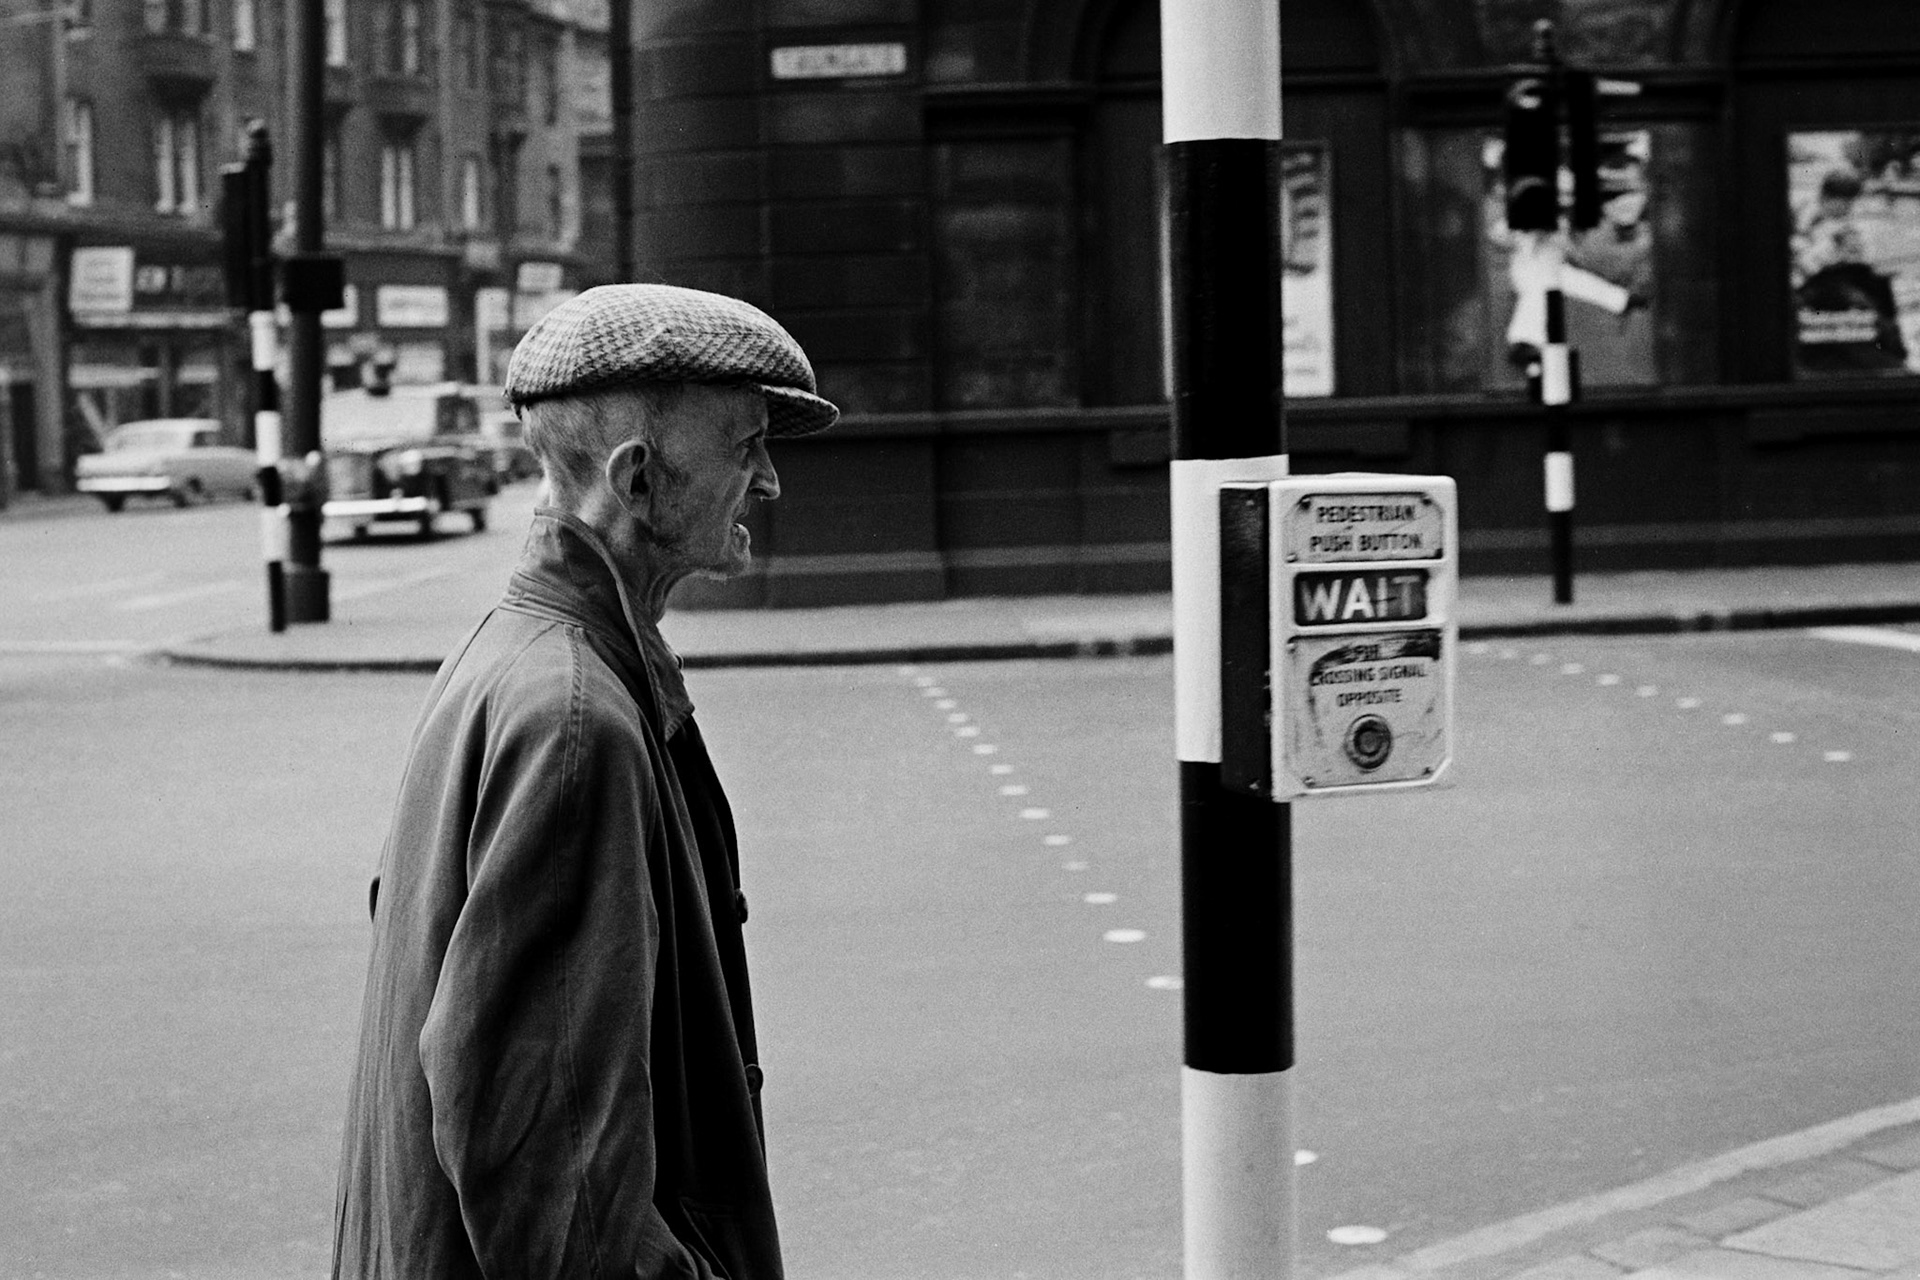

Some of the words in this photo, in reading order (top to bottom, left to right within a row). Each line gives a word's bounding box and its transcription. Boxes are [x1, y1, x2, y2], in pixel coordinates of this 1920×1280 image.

[1316, 505, 1416, 522] PEDESTRIAN
[1310, 535, 1353, 552] PUSH
[1359, 533, 1422, 551] BUTTON
[1301, 576, 1420, 620] WAIT
[1310, 667, 1376, 686] CROSSING
[1379, 663, 1428, 680] SIGNAL
[1336, 688, 1402, 707] OPPOSITE
